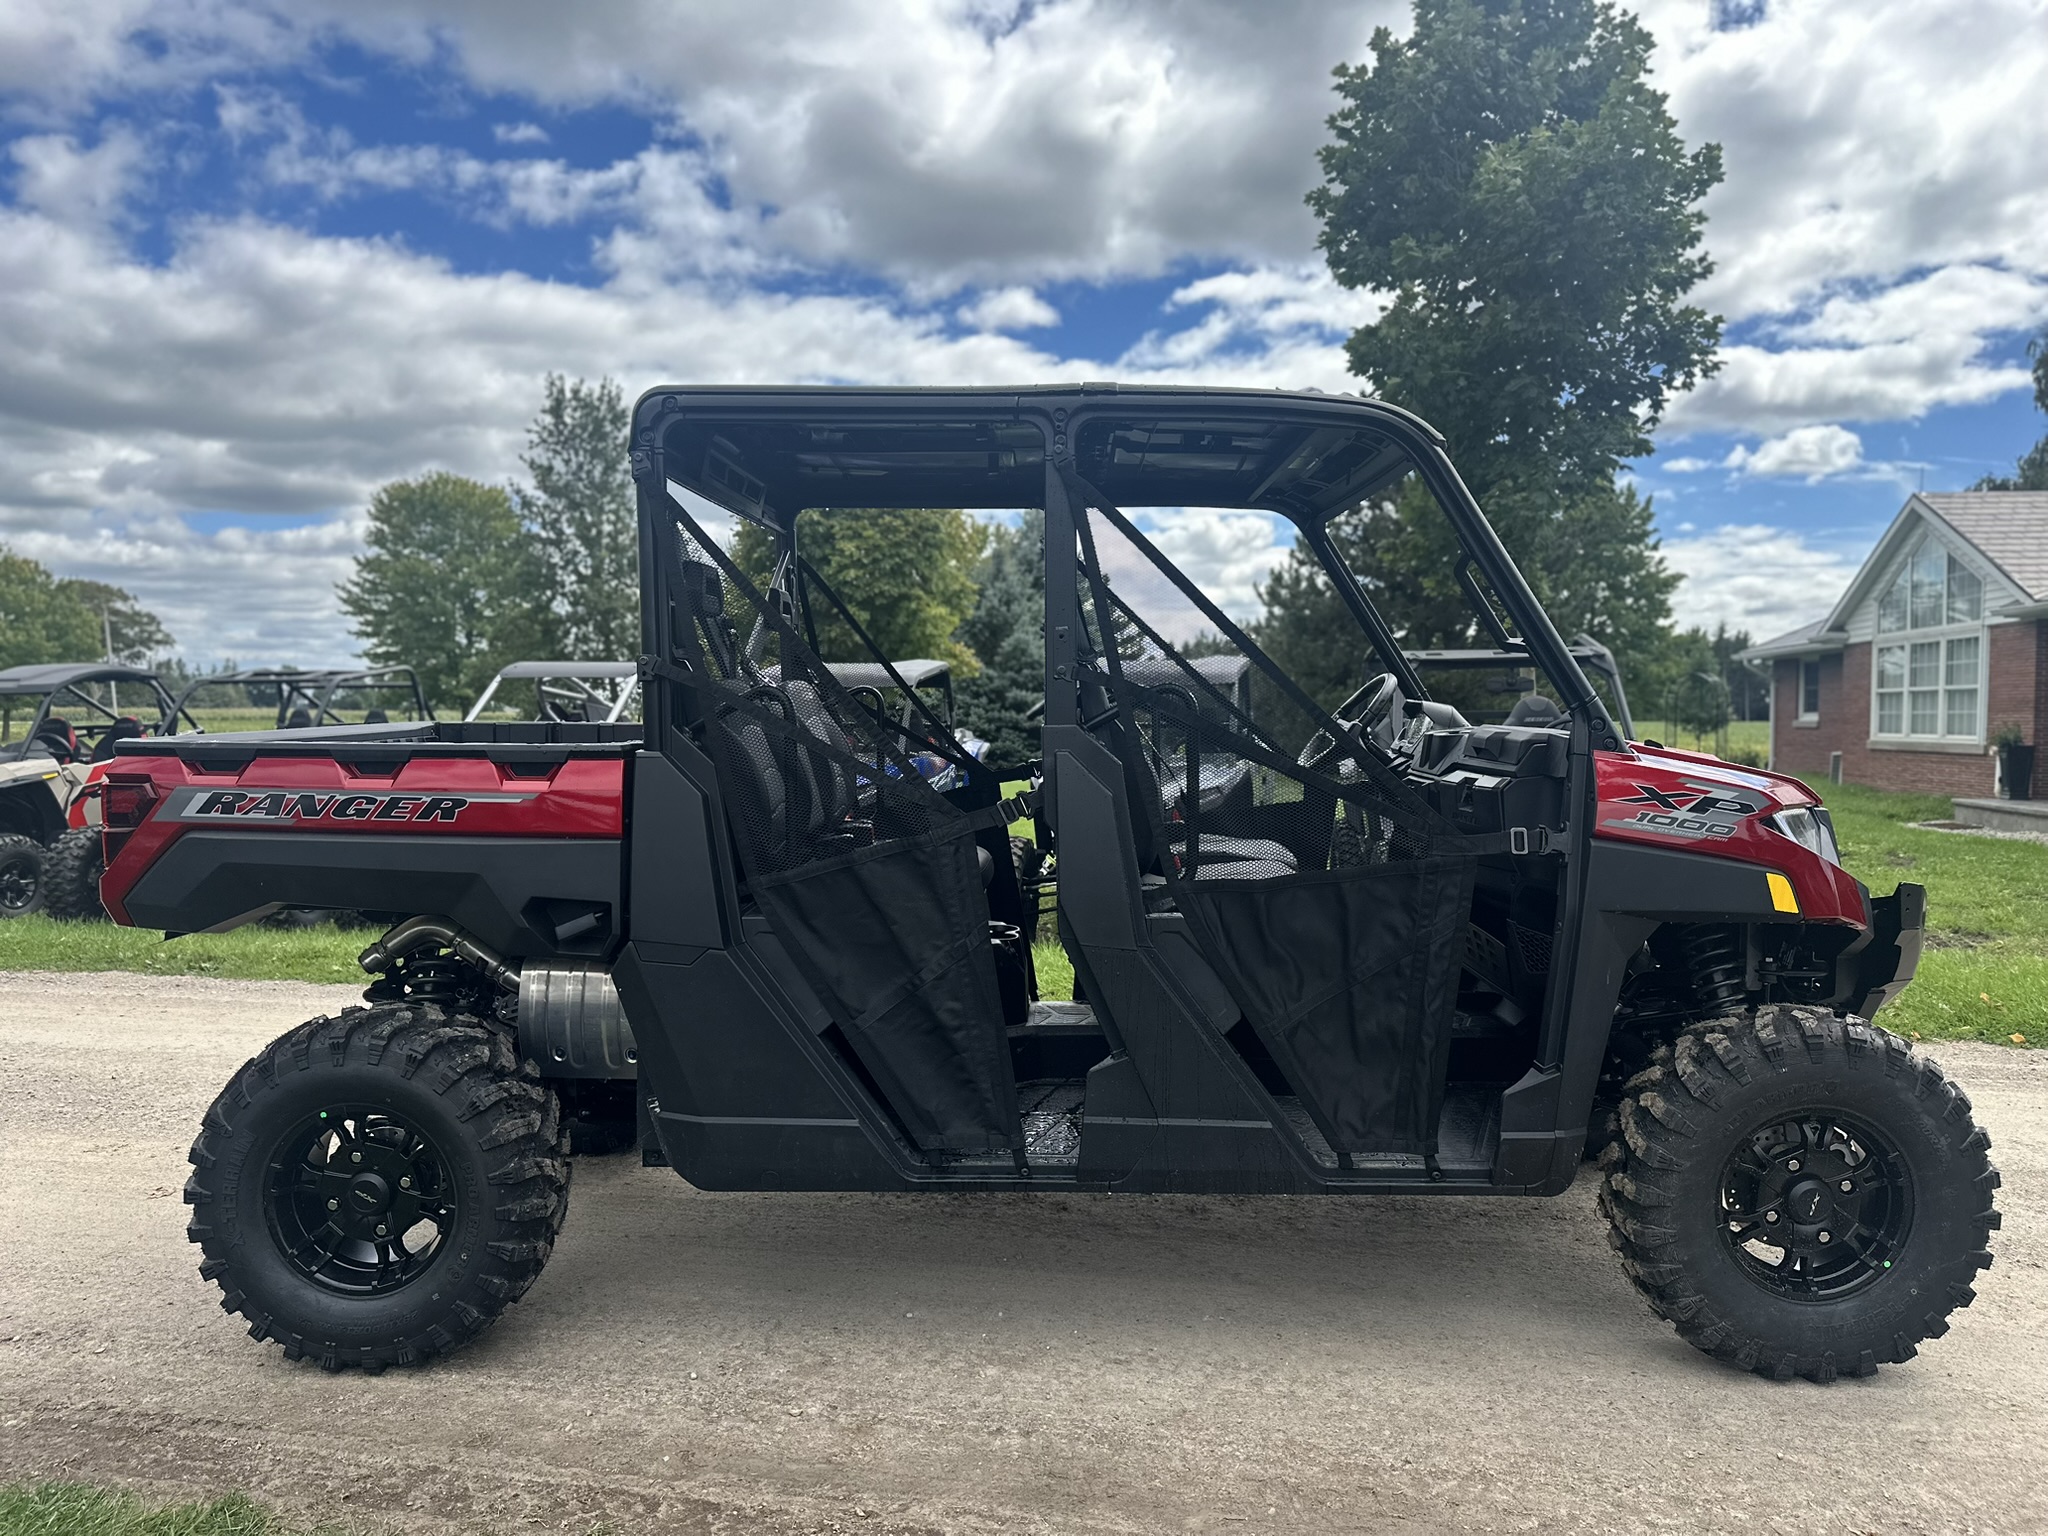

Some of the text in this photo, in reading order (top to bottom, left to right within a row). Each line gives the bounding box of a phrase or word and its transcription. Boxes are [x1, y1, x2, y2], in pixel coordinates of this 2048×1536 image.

[194, 790, 469, 823] RANGER
[1607, 782, 1759, 816] XP
[1632, 823, 1656, 832] DUAL
[1707, 835, 1729, 843] CAM
[1634, 810, 1738, 837] 1000
[221, 1128, 258, 1250] X-TERRAIN
[459, 1160, 480, 1199] PRO
